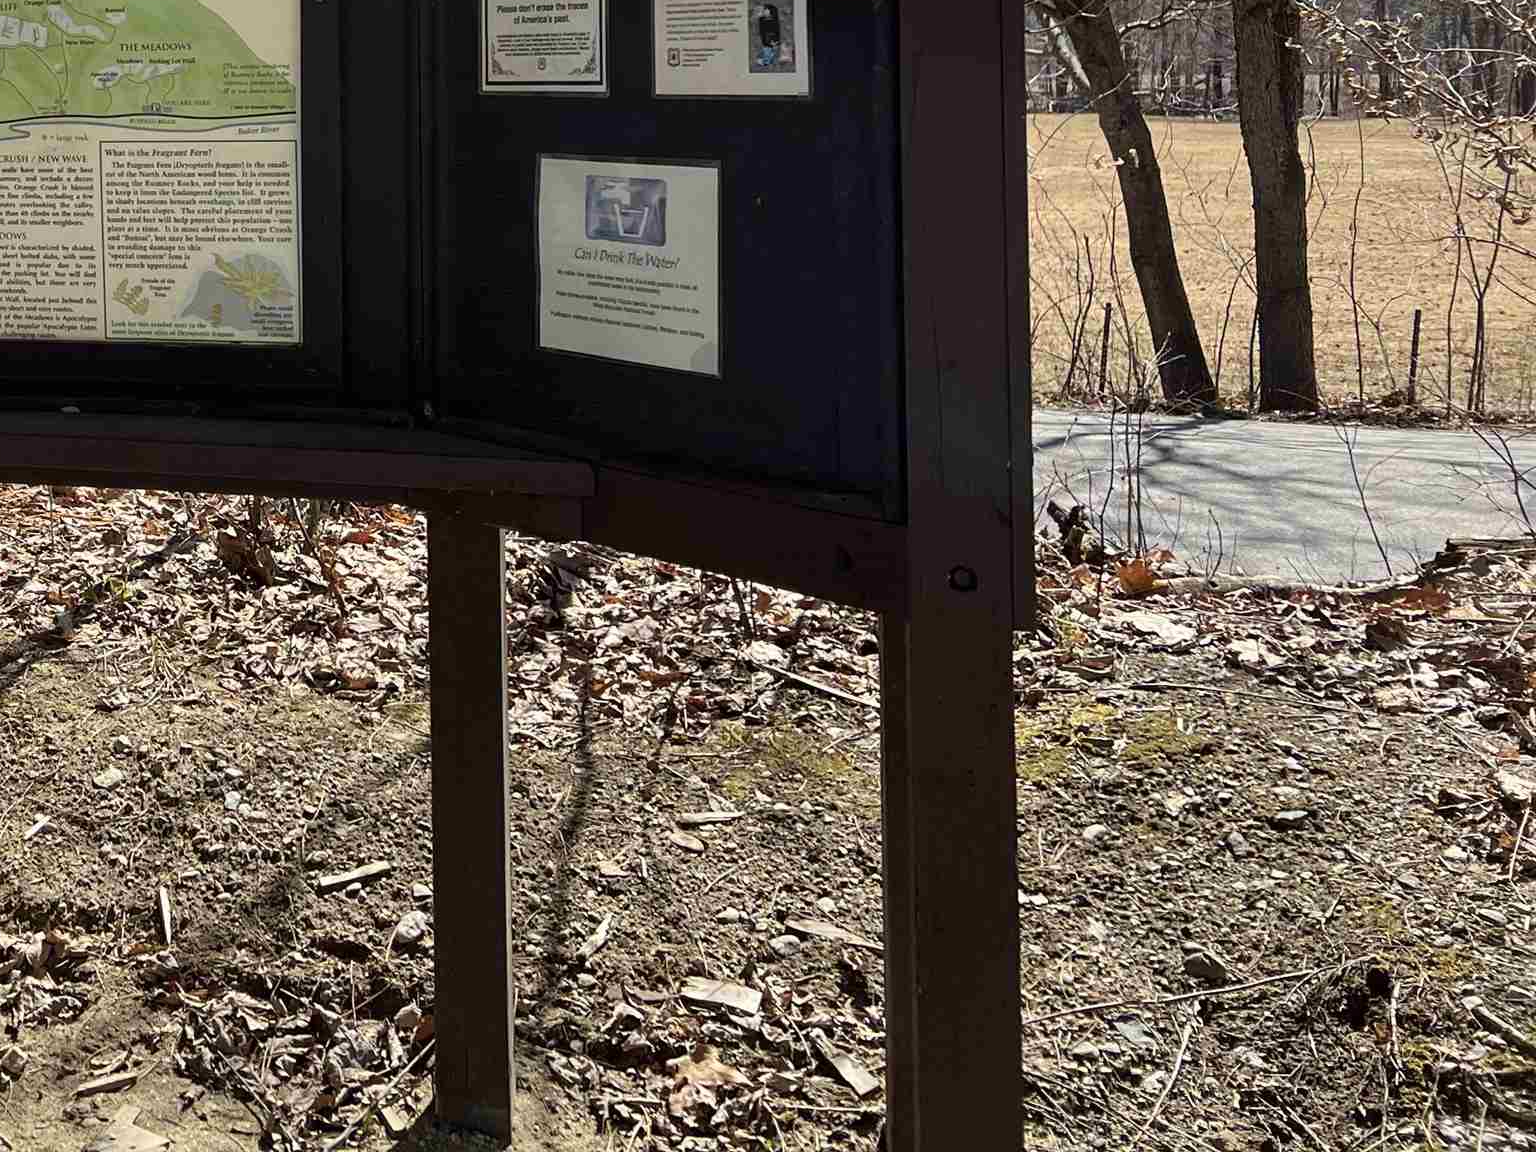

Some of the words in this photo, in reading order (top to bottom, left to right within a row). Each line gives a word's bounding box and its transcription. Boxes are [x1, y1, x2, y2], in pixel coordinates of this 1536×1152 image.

[120, 42, 139, 52] THE
[140, 42, 192, 52] MEADOWS
[38, 154, 60, 163] NEW
[61, 154, 87, 163] WAVE
[105, 148, 126, 157] What
[127, 149, 135, 157] is
[136, 148, 150, 157] the
[151, 148, 188, 159] Fragrant
[189, 148, 212, 157] Fern?
